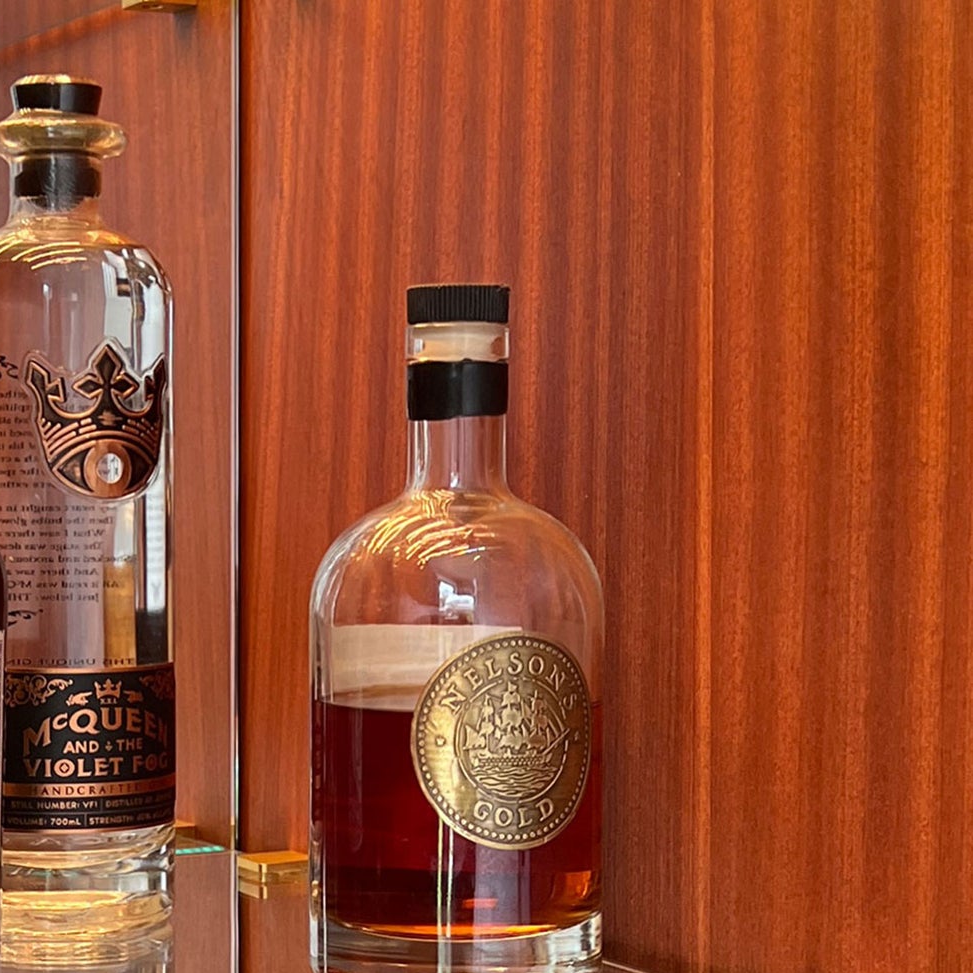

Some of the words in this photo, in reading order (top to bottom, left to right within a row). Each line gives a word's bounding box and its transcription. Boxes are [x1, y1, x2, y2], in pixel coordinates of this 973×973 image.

[440, 652, 578, 716] NELSON'S
[62, 740, 100, 755] AND
[115, 737, 144, 751] THE
[23, 756, 125, 778] VIOLET
[132, 752, 169, 774] FOG
[473, 797, 555, 828] GOLD
